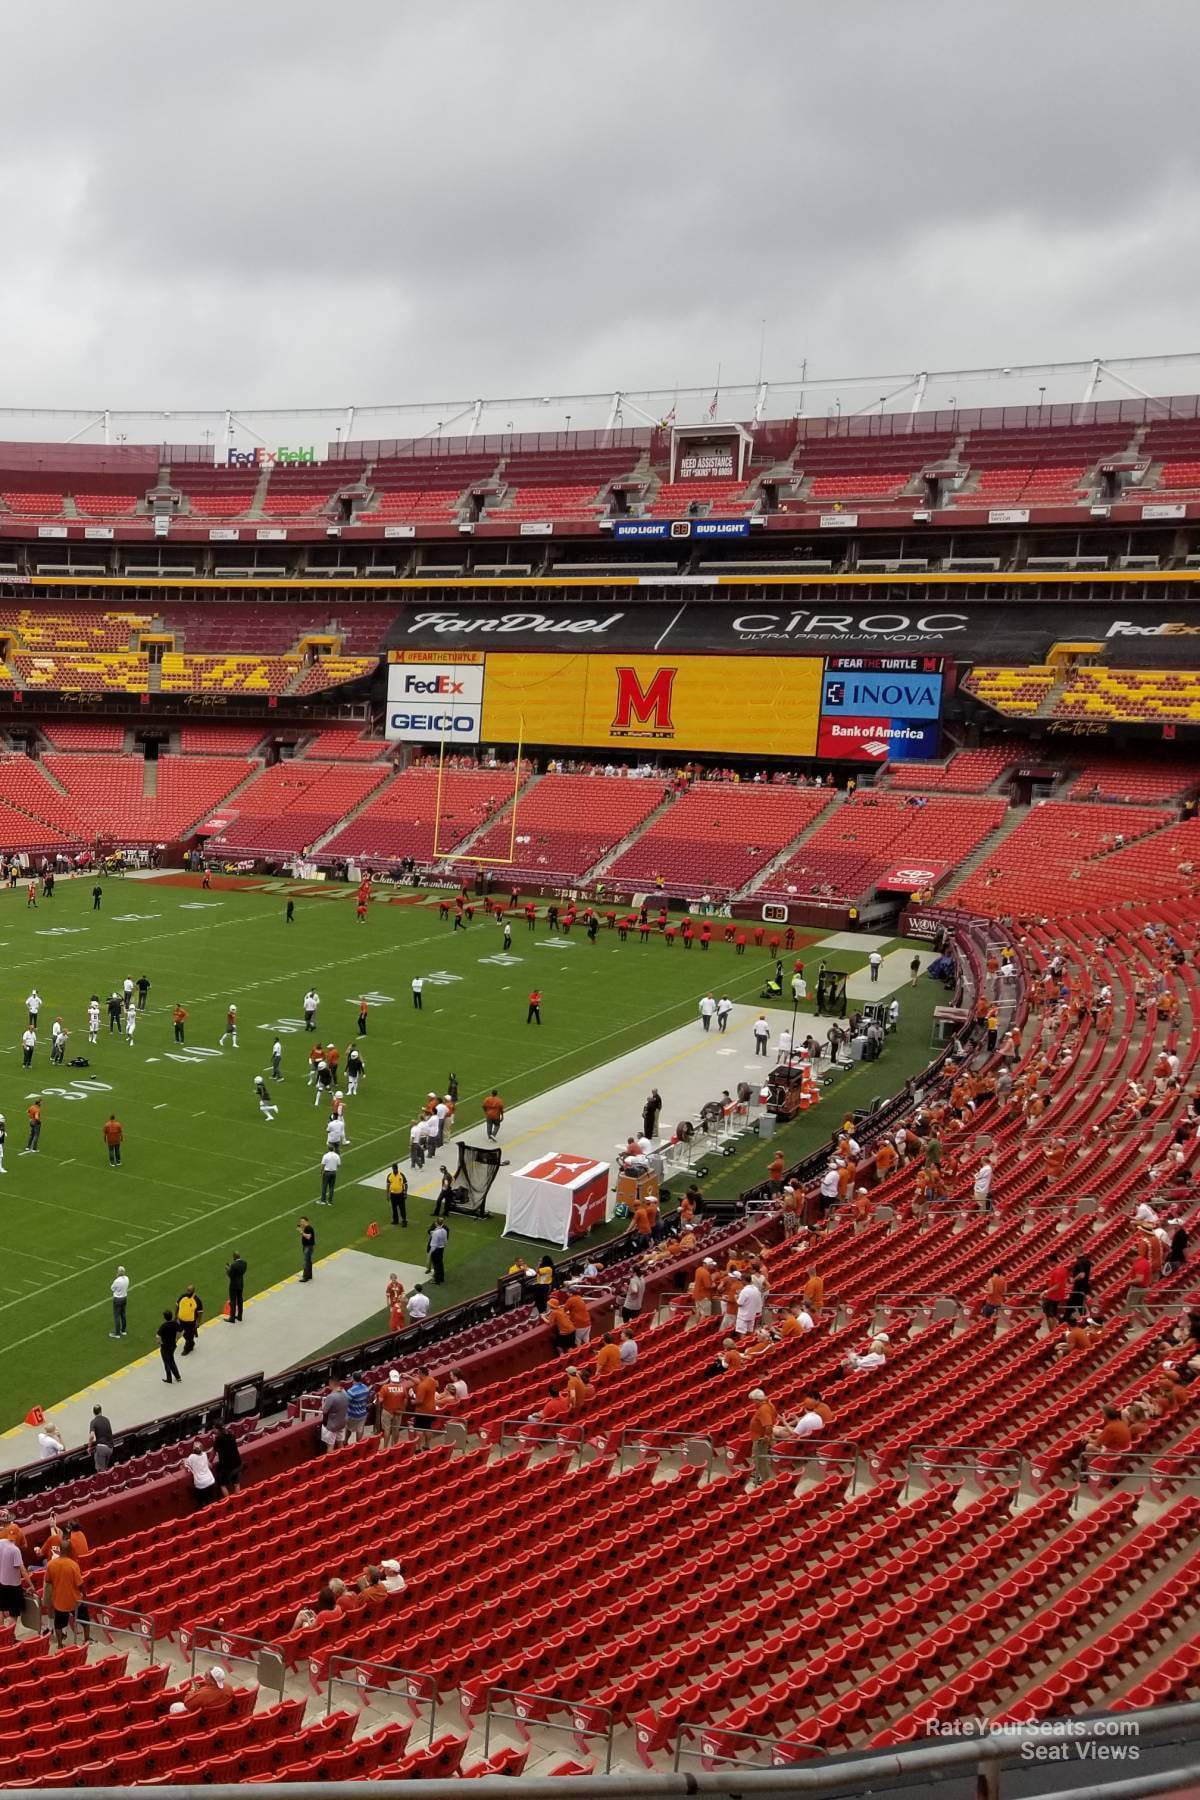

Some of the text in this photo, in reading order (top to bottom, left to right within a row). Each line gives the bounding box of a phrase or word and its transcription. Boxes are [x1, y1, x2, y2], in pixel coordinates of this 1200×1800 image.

[228, 446, 314, 463] FedExField
[681, 456, 733, 468] NEED ASSISTANCE
[618, 525, 665, 534] BUD LIGHT
[696, 524, 745, 534] BUD LIGHT
[407, 612, 625, 634] FanDuel
[883, 633, 944, 641] VODKA
[404, 674, 464, 694] FedEx
[611, 667, 678, 729] M
[852, 684, 936, 706] INOVA
[390, 713, 475, 732] GEICO
[831, 725, 924, 739] Bank of America
[257, 1018, 307, 1034] 50
[163, 1045, 225, 1063] 40
[41, 1080, 114, 1102] 30
